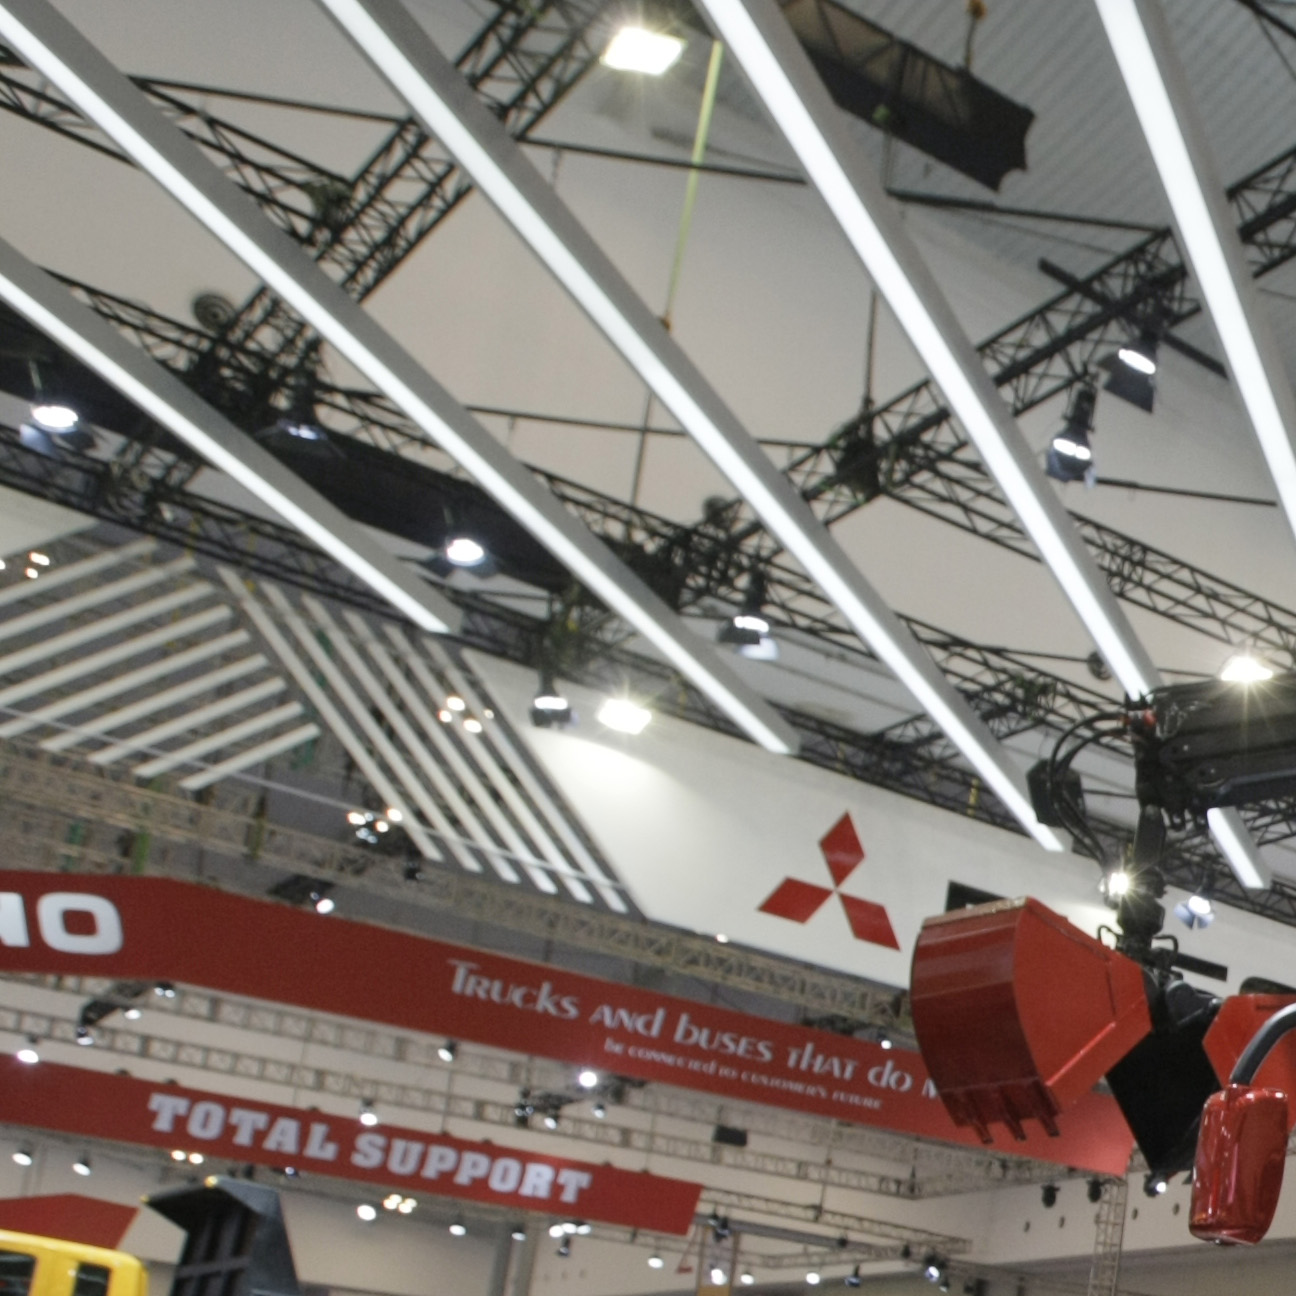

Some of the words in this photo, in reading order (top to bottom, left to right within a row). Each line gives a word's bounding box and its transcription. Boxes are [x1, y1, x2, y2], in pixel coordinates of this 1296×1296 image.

[867, 1059, 913, 1092] do
[147, 1092, 338, 1161] TOTAL
[350, 1132, 592, 1203] SUPPORT
